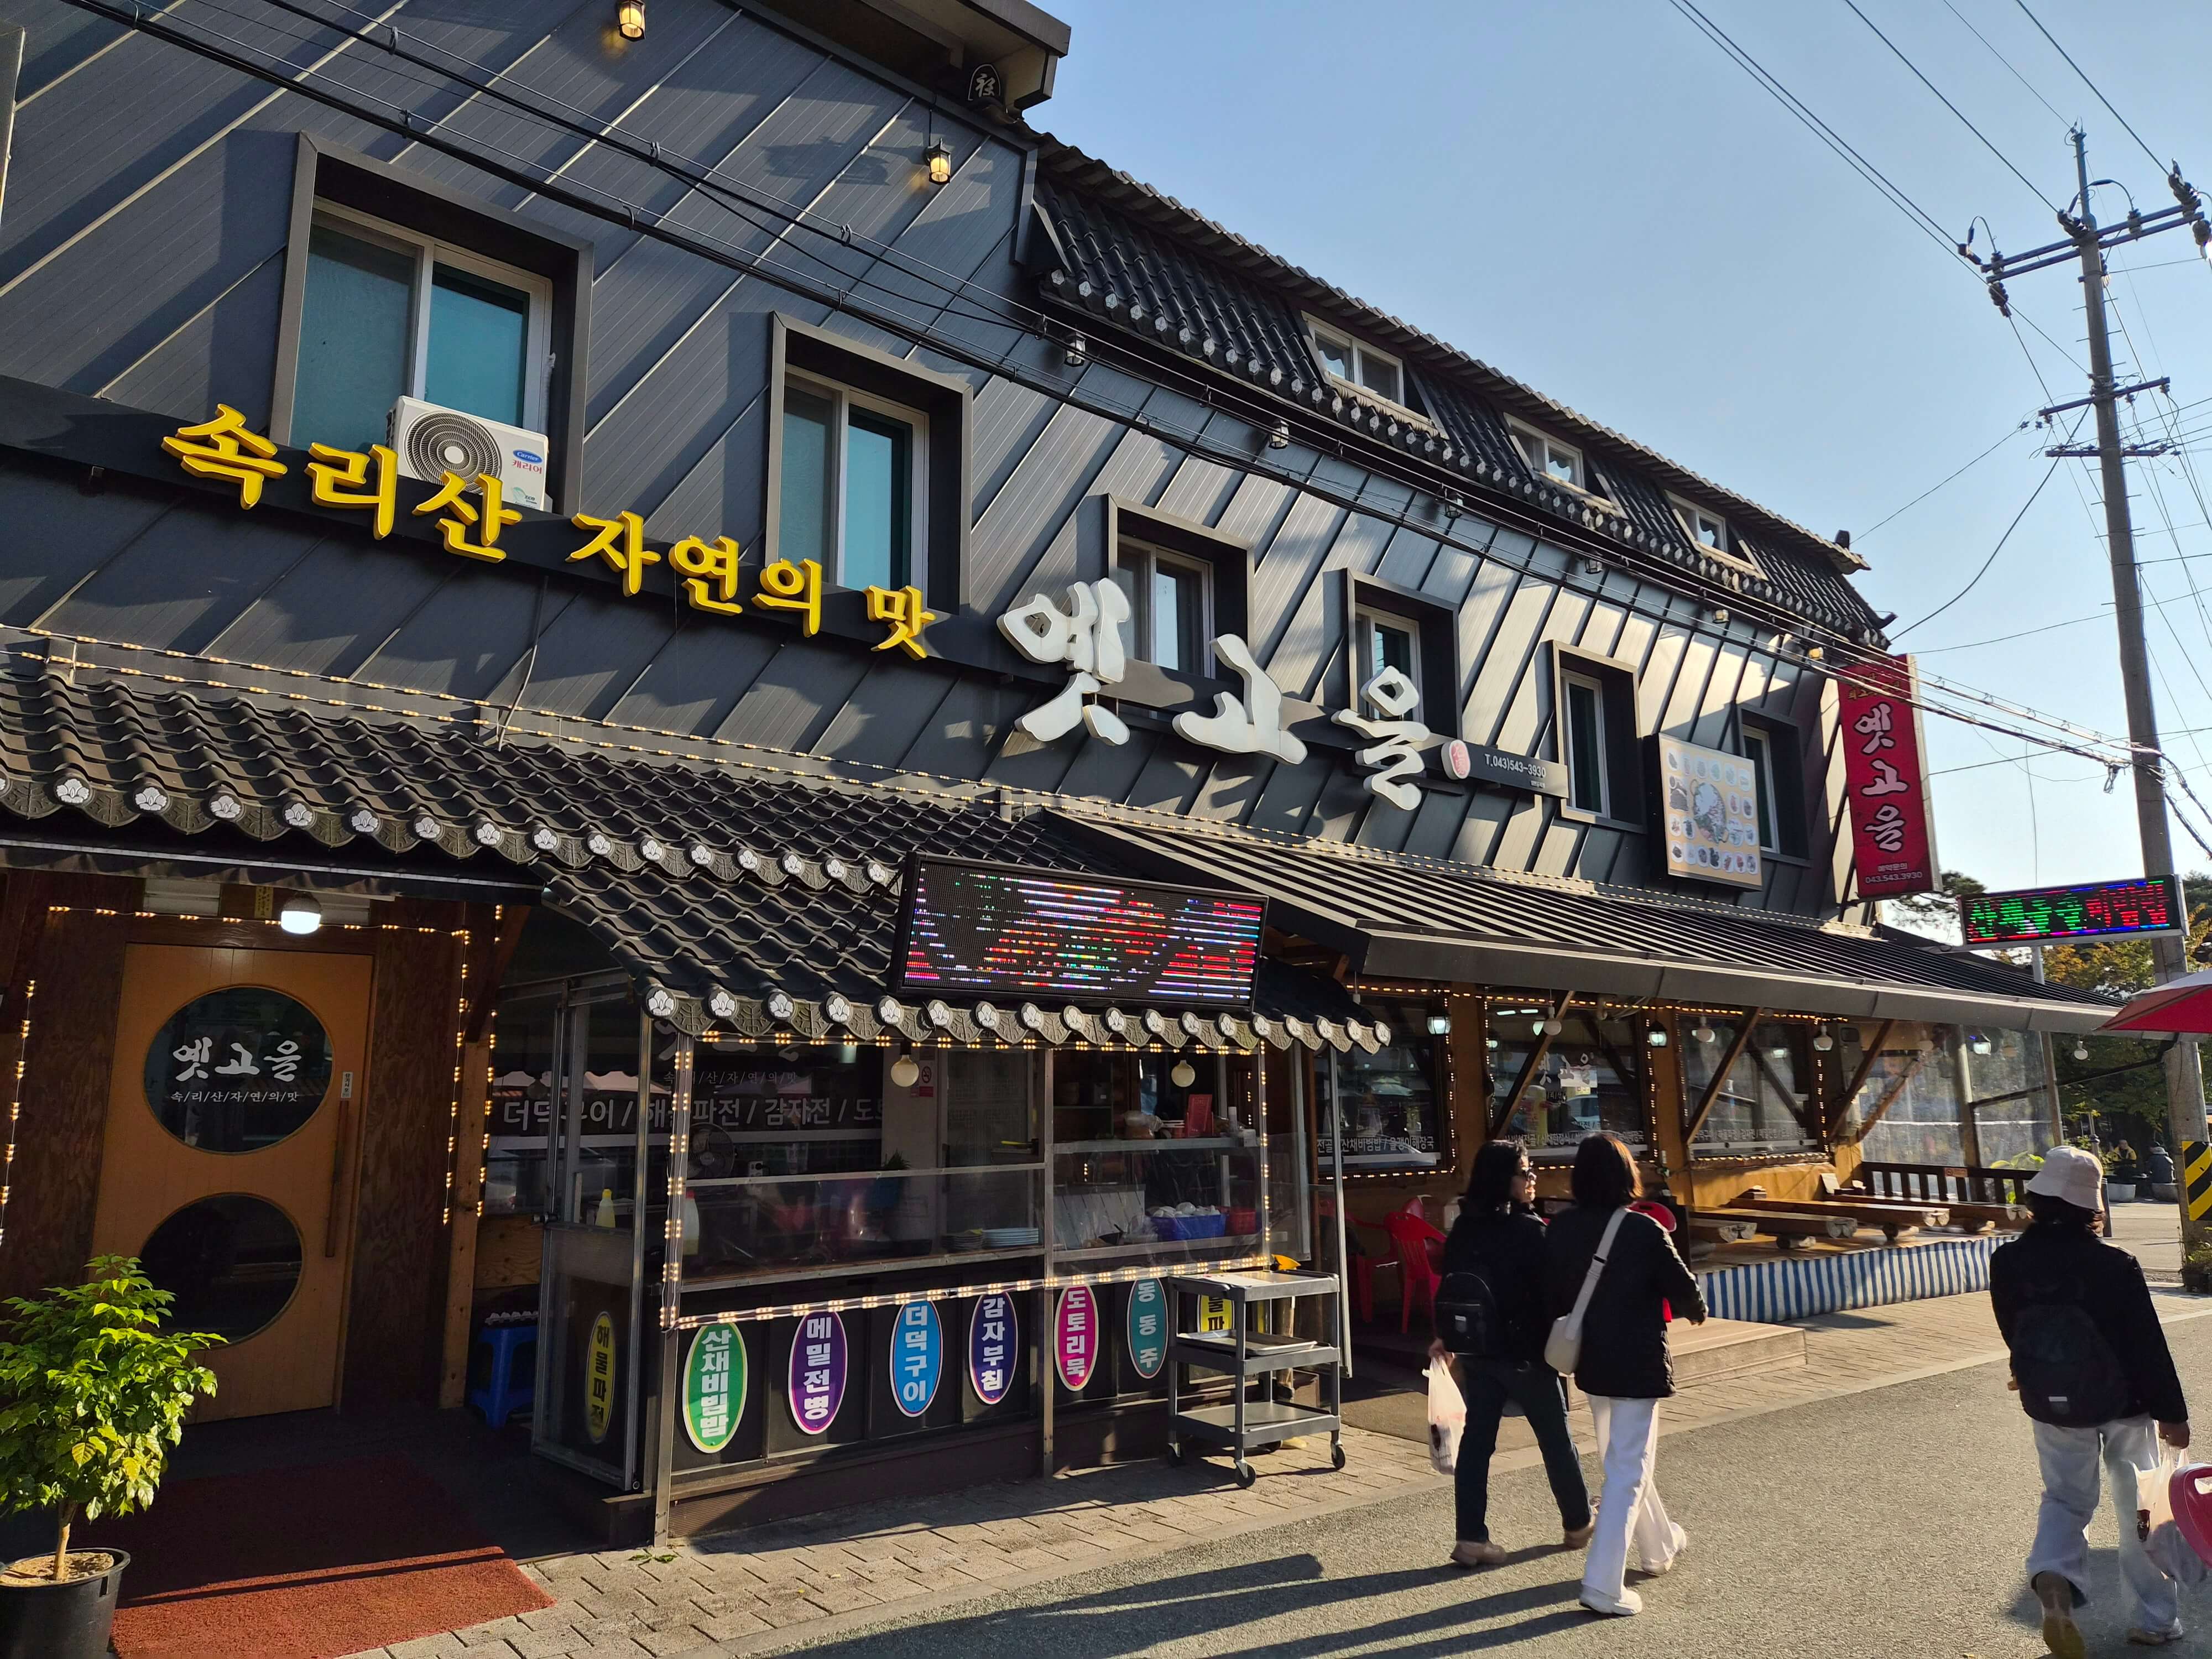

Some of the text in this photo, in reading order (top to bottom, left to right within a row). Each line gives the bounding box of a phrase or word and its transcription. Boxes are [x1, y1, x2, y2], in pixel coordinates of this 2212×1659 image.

[513, 459, 542, 474] 캐리어
[517, 451, 540, 461] Carrier
[162, 403, 937, 661] 속리산 자연의 맛
[996, 577, 1431, 811] 옛고을
[1853, 702, 1909, 852] 옛고을
[173, 1037, 302, 1082] 옛고을
[764, 1098, 830, 1126] 감자전
[802, 1316, 832, 1420] 메밀전병
[903, 1305, 928, 1402] 더덕구이
[980, 1297, 1005, 1392] 감자부침
[1066, 1286, 1087, 1378] 도토리묵
[1137, 1281, 1158, 1369] 동동주
[700, 1329, 732, 1438] 산채비빔밥
